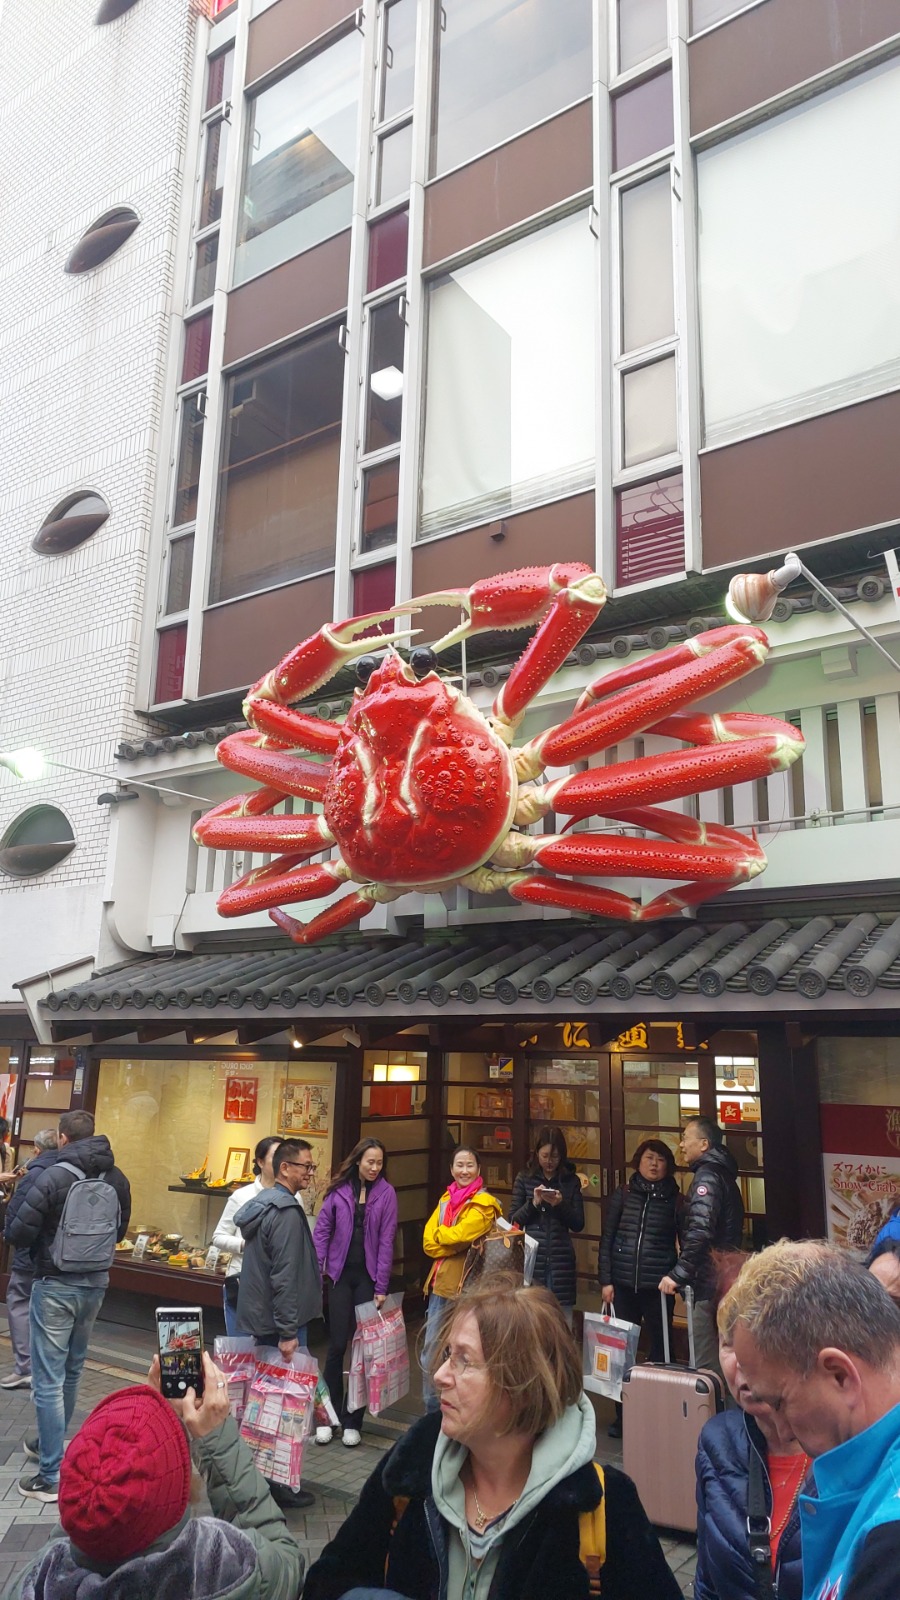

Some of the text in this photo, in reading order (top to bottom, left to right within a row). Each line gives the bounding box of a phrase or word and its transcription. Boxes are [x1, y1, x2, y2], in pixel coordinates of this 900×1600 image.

[833, 1162, 887, 1176] ズワイかに
[833, 1178, 897, 1193] Snow Crab
